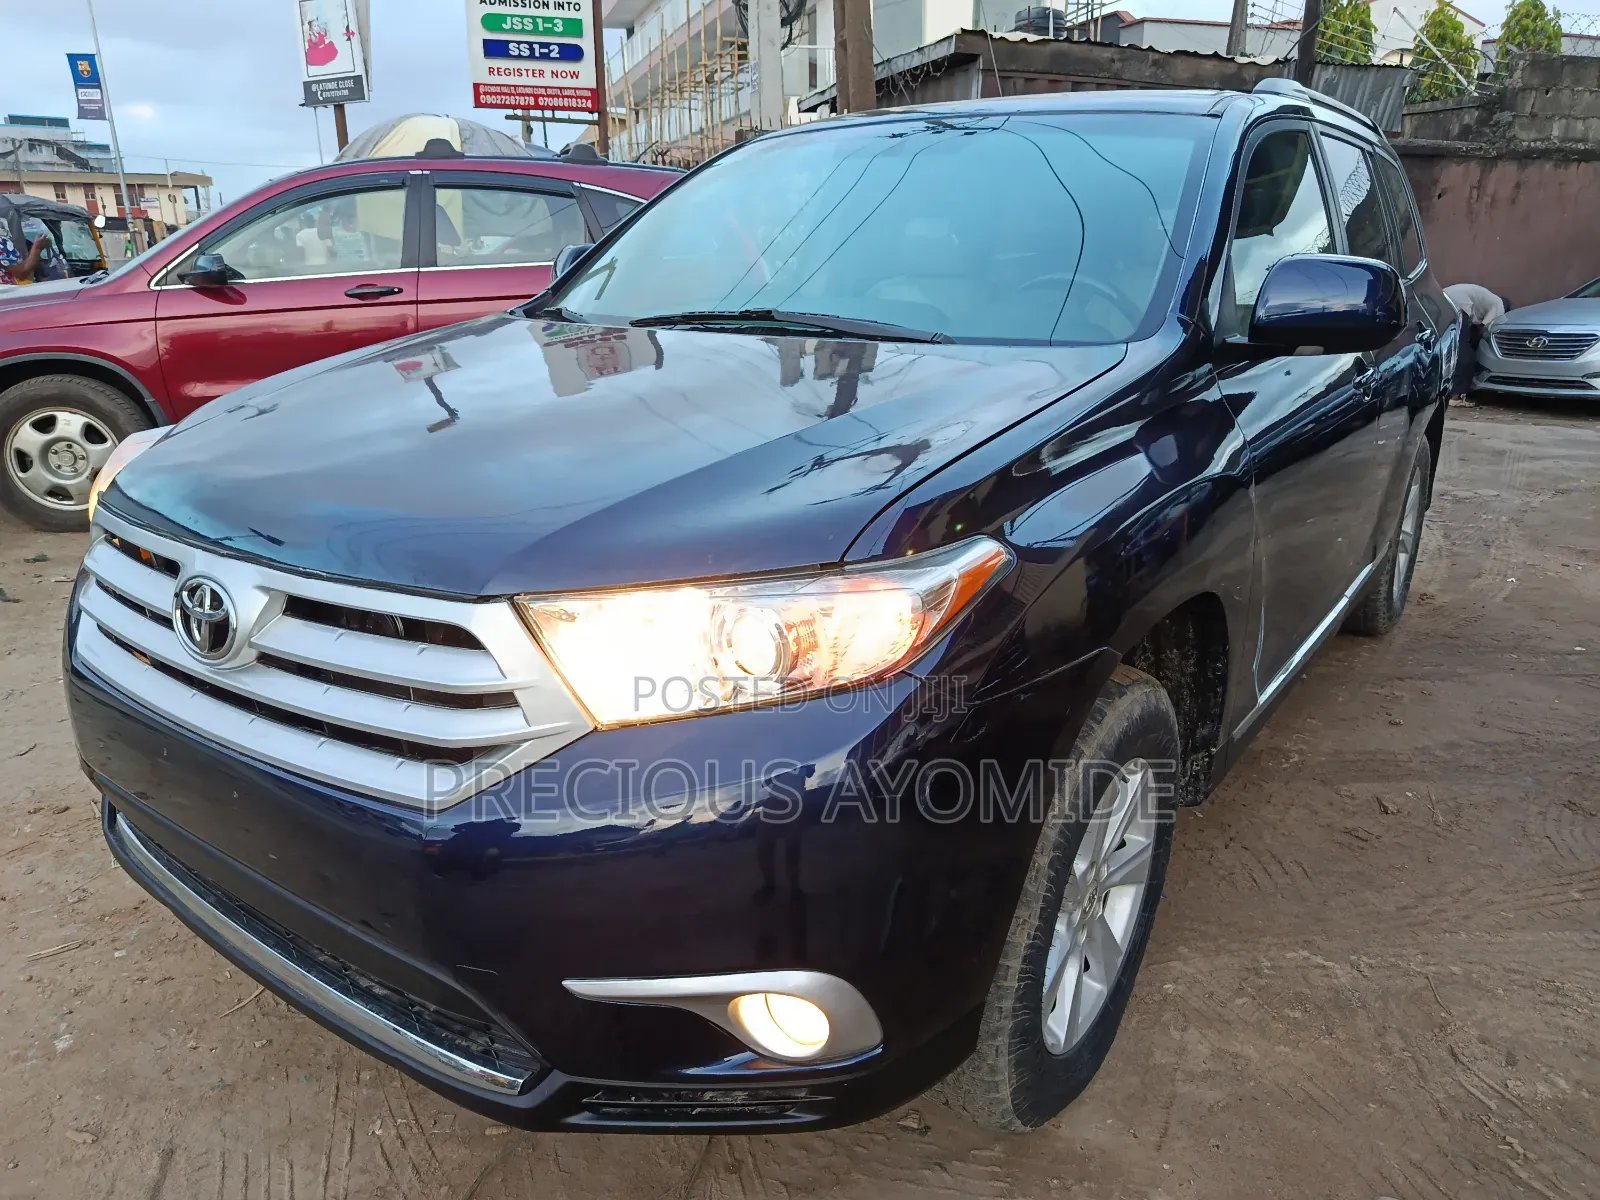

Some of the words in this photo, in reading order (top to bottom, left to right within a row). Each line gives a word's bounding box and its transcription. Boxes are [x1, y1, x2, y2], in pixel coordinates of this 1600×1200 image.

[479, 0, 550, 10] ADMISSION
[554, 1, 581, 12] INTO
[502, 16, 533, 30] JSS
[536, 18, 564, 32] 1-3
[508, 42, 530, 56] SS
[533, 43, 560, 58] 1-2
[488, 66, 545, 78] REGISTER
[551, 69, 580, 80] NOW
[338, 79, 355, 89] CLOSE
